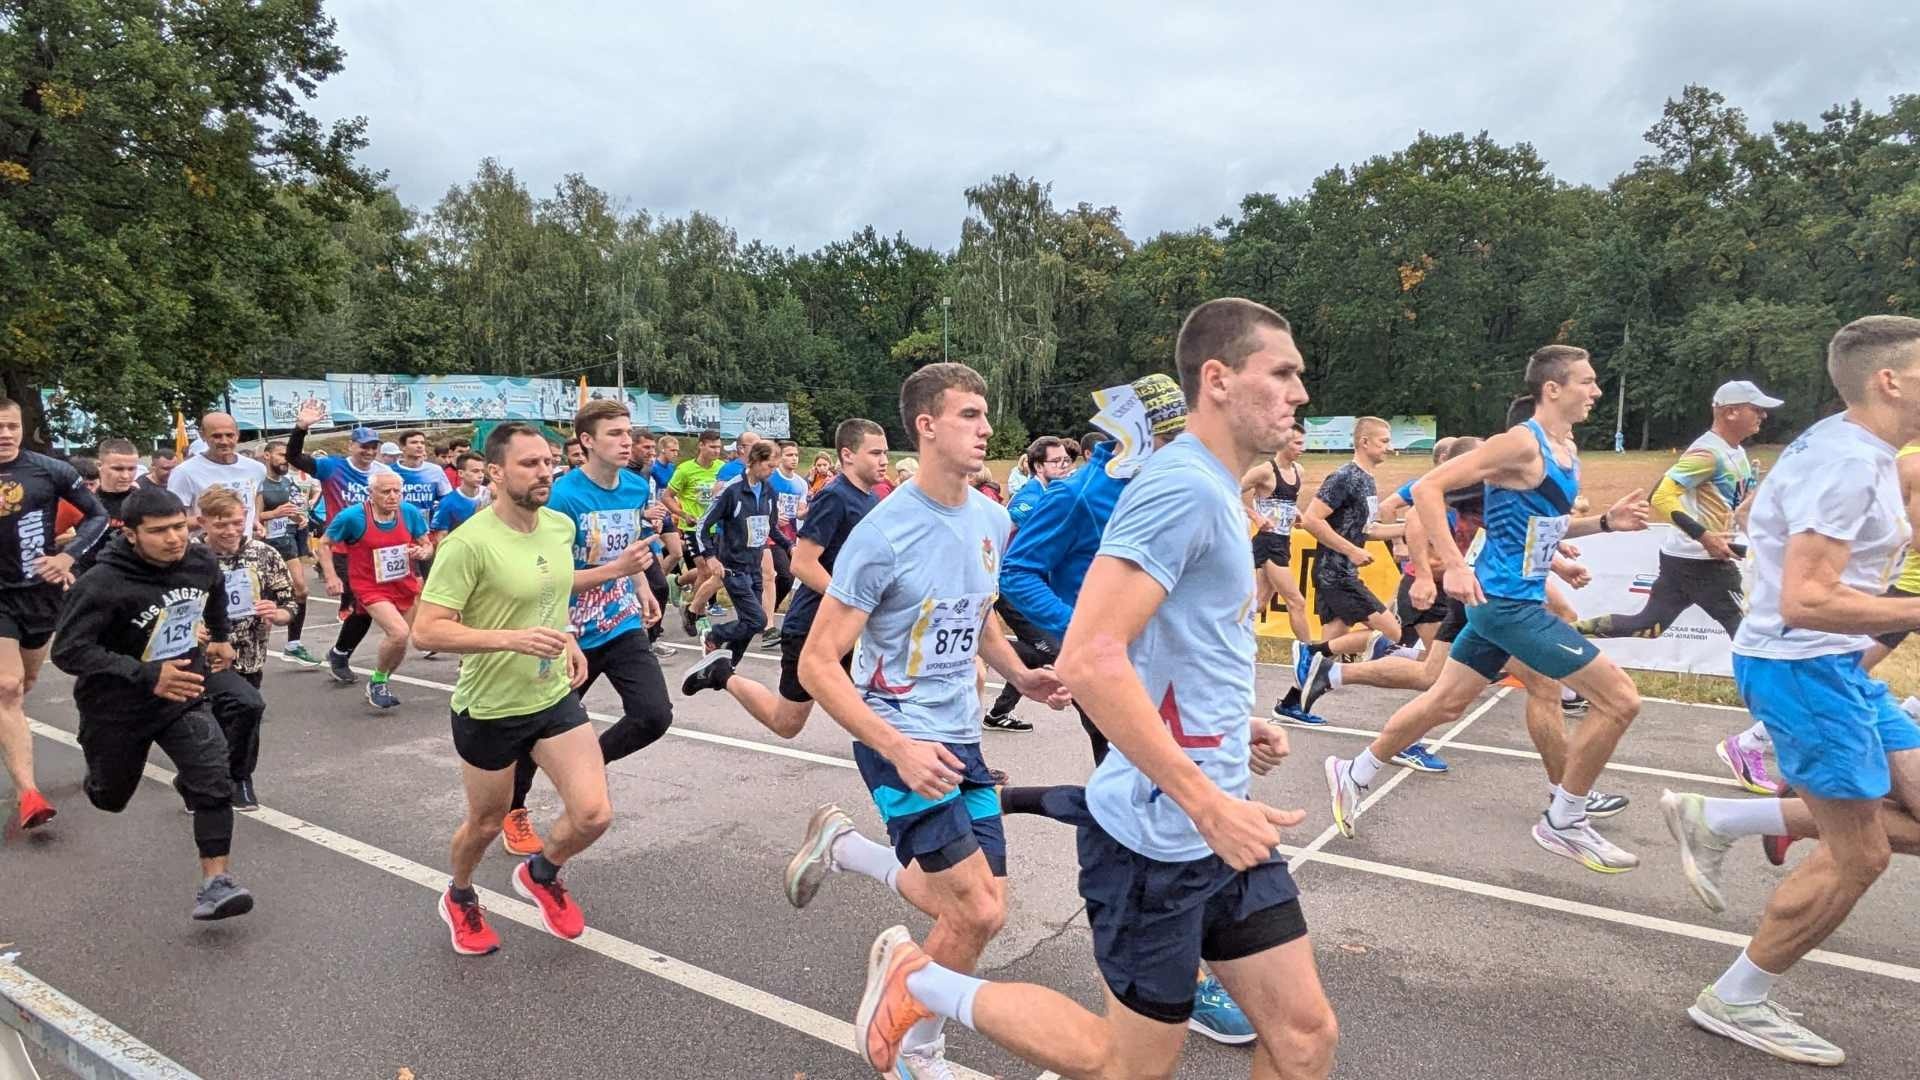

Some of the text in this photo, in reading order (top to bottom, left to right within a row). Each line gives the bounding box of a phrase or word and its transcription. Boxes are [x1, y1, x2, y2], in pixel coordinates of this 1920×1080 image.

[607, 533, 630, 552] 933
[386, 559, 407, 573] 622
[131, 604, 161, 629] LOS
[935, 627, 975, 655] 875
